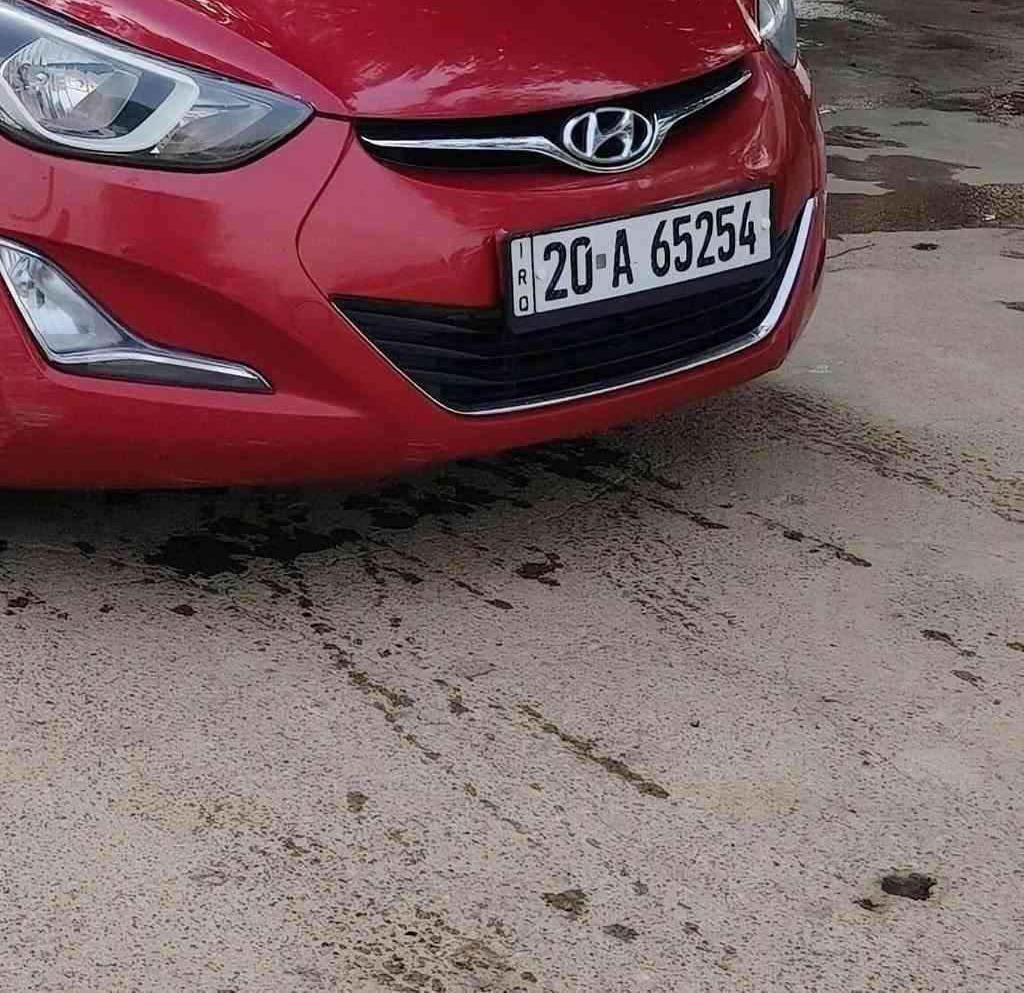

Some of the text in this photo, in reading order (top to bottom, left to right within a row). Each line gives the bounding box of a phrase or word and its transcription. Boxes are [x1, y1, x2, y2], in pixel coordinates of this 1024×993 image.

[543, 200, 757, 302] 20 A 65254
